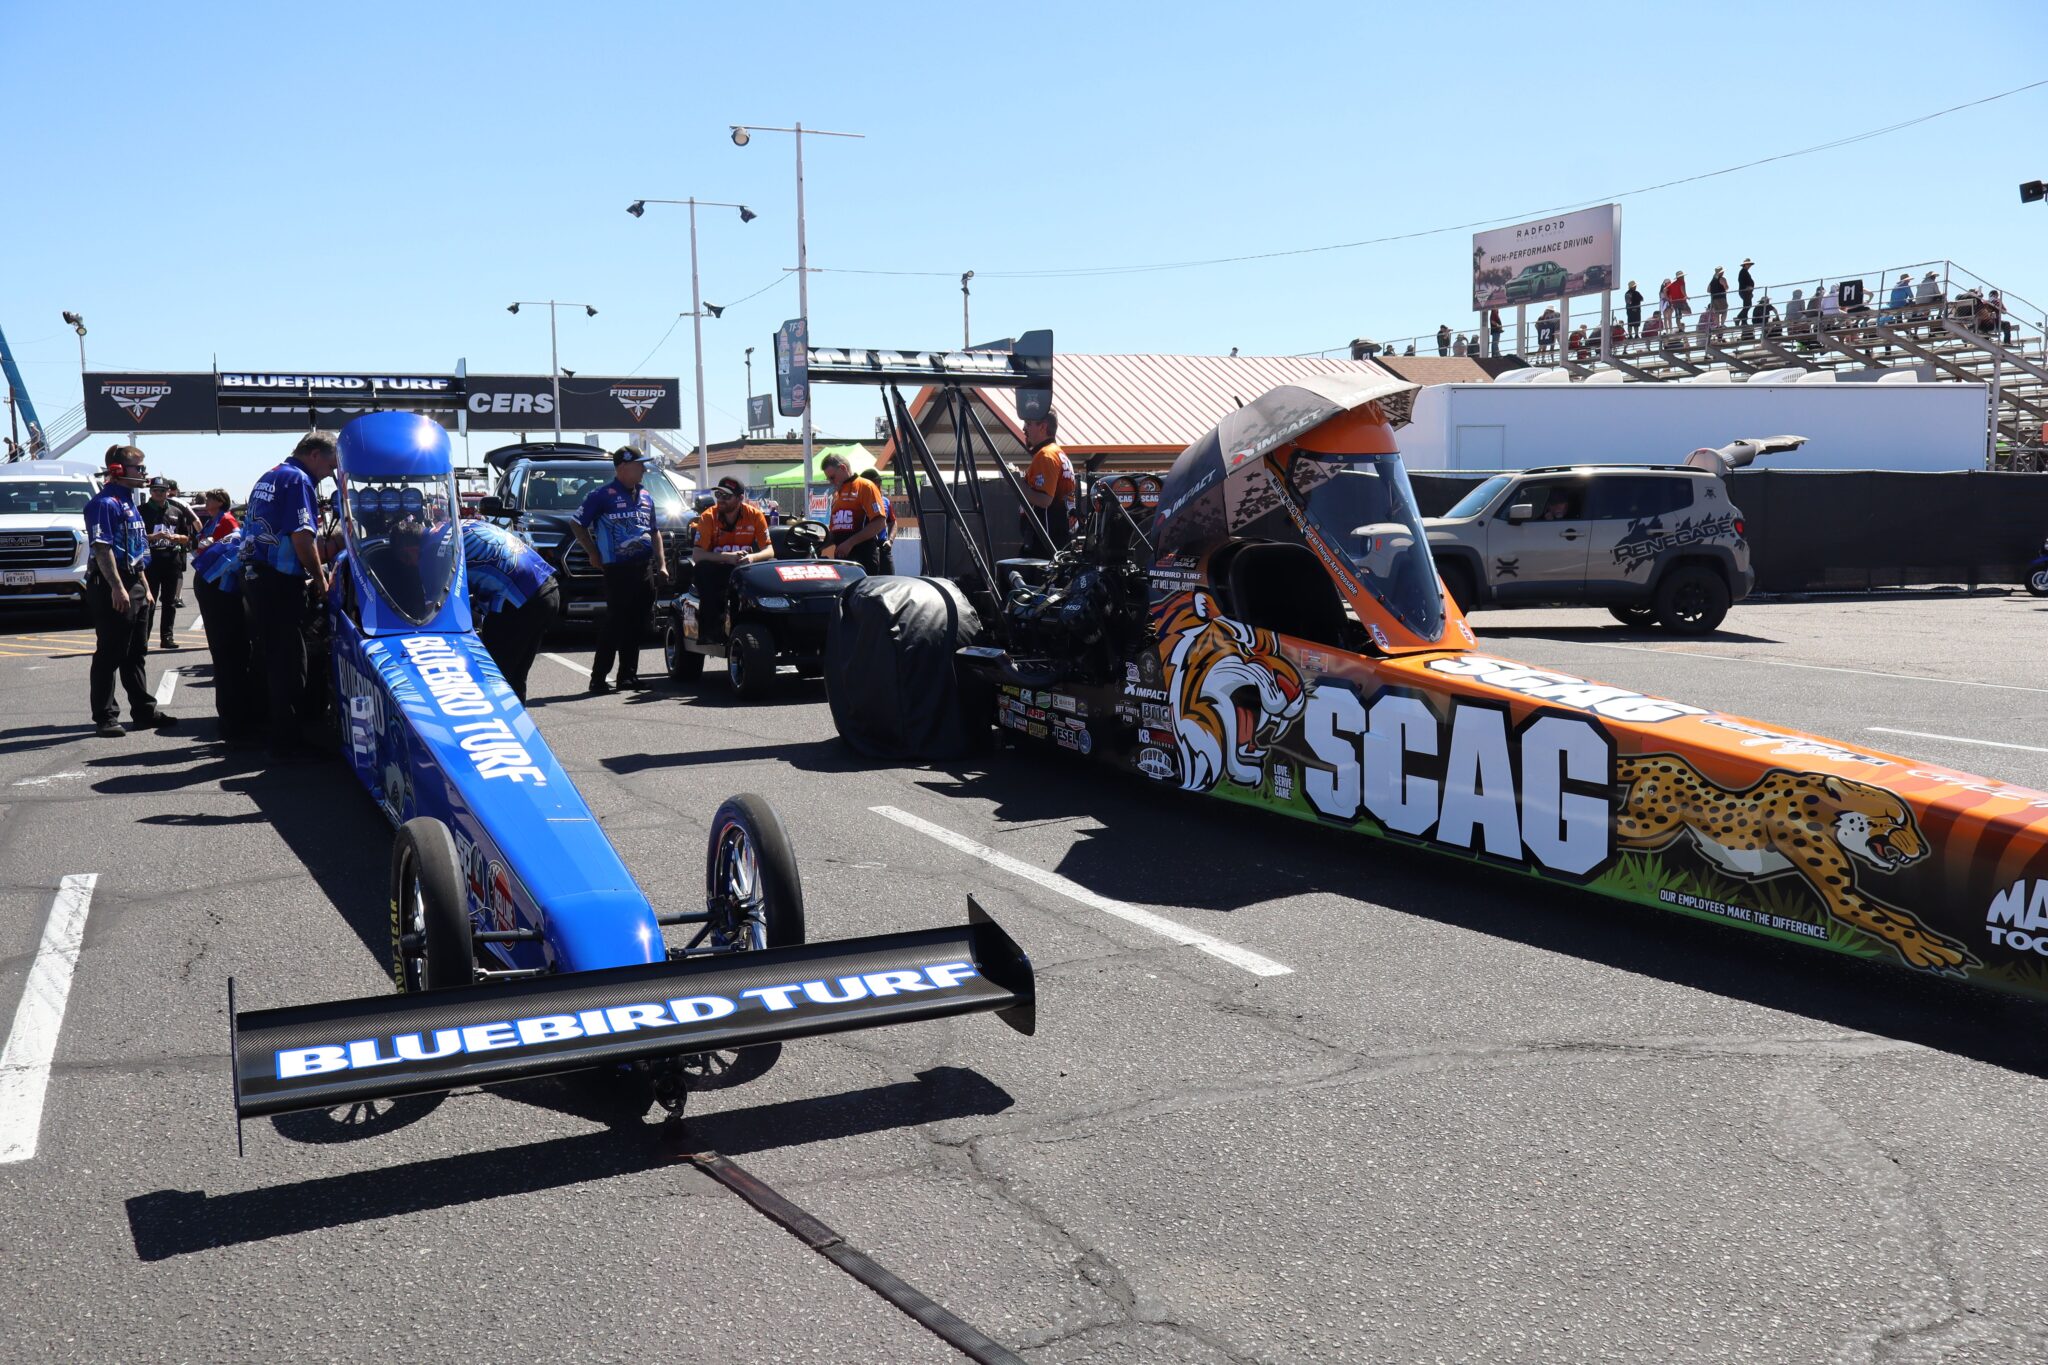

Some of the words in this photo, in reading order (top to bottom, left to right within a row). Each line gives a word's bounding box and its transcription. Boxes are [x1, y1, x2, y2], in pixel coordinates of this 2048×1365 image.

[1516, 221, 1565, 238] RADFORD
[1490, 241, 1562, 264] HIGH-PERFORMANCE
[1563, 235, 1594, 250] DRIVING
[1843, 285, 1856, 302] P1
[100, 385, 171, 395] FIREBIRD
[223, 374, 364, 390] BLUEBIRD
[371, 377, 449, 390] TURF
[609, 388, 666, 398] FIREBIRD
[468, 393, 554, 413] CERS
[1256, 409, 1322, 450] IMPACT
[1140, 495, 1159, 503] SCAG
[1172, 468, 1217, 513] IMPACT
[1613, 519, 1733, 566] RENEGADE
[779, 565, 834, 574] SCAG
[1317, 542, 1332, 563] Things
[1329, 559, 1339, 573] Are
[1149, 569, 1181, 579] BLUEBIRD
[1183, 572, 1202, 580] TURF
[401, 636, 494, 716] BLUEBIRD
[1426, 656, 1710, 722] SCAG
[1136, 687, 1168, 700] IMPACT
[453, 717, 547, 783] TURF
[1273, 763, 1290, 777] LOVE.
[1274, 776, 1295, 790] SERVE.
[1304, 684, 1609, 875] SCAG
[1660, 889, 1677, 904] OUR
[1678, 894, 1725, 915] EMPLOYEES
[1727, 905, 1752, 921] MAKE
[1753, 911, 1770, 926] THE
[1772, 916, 1828, 940] DIFFERENCE.
[1986, 878, 2048, 932] MA
[1985, 924, 2048, 957] TOO
[275, 995, 738, 1080] BLUEBIRD
[740, 962, 980, 1013] TURF
